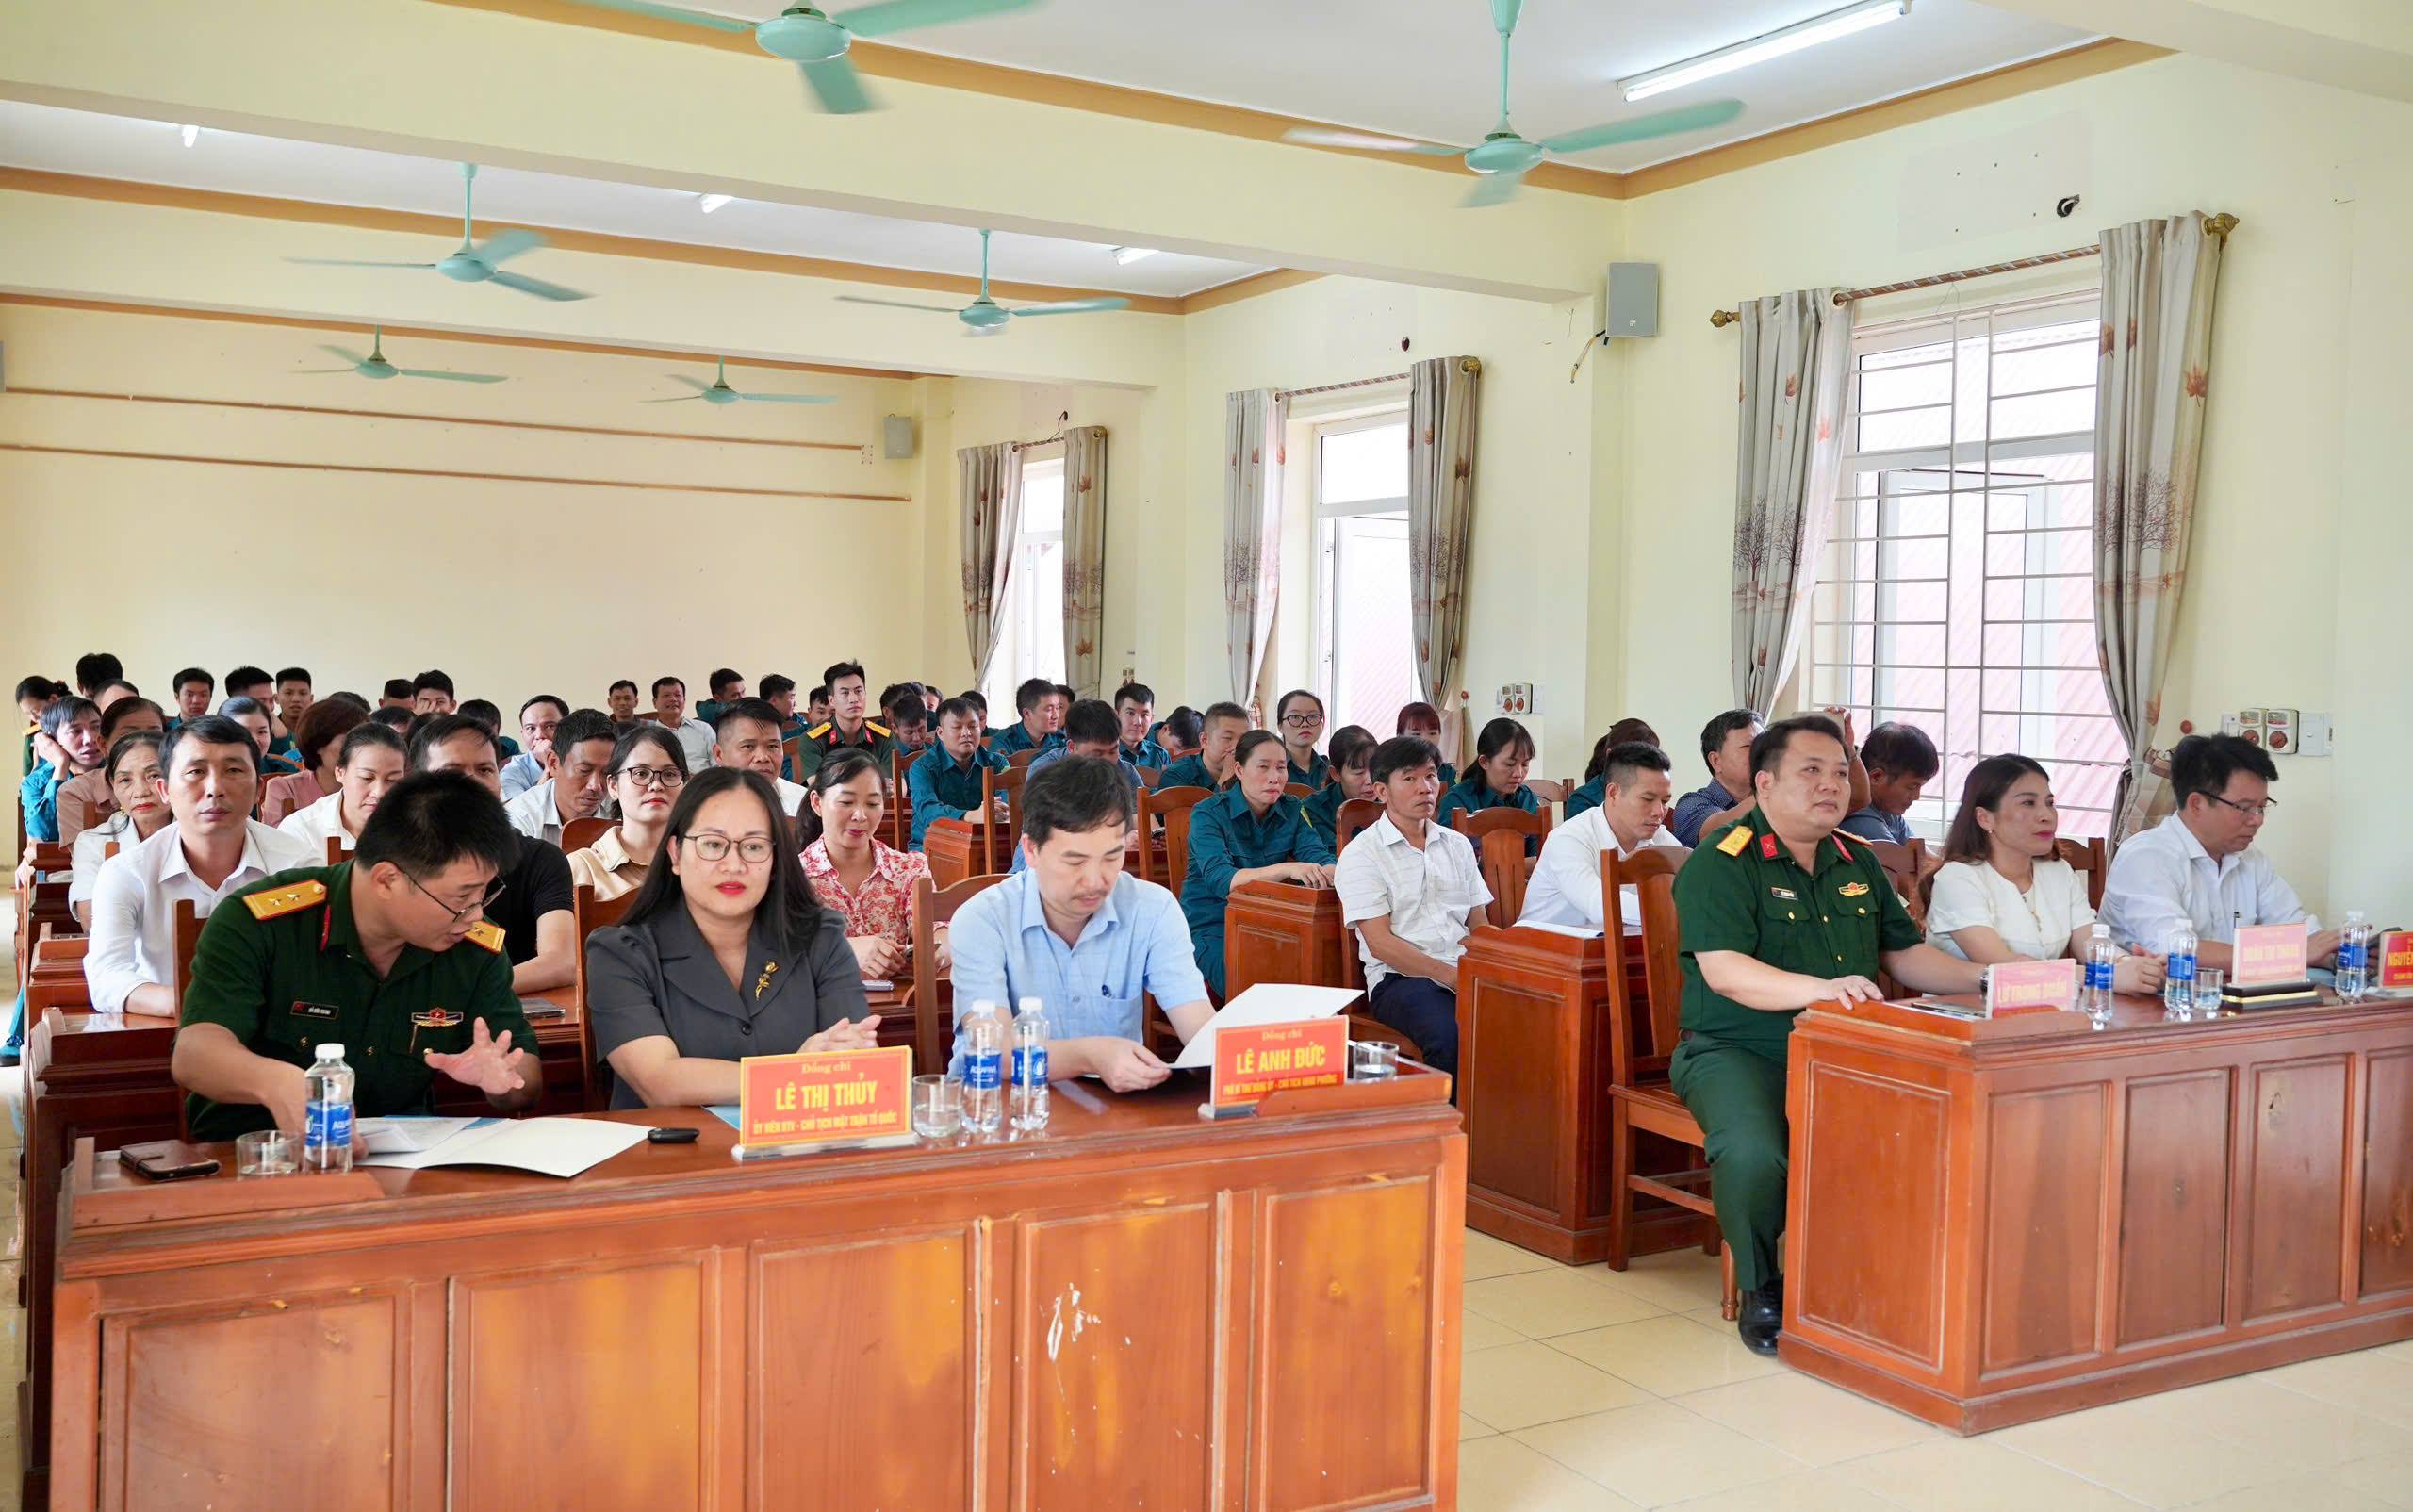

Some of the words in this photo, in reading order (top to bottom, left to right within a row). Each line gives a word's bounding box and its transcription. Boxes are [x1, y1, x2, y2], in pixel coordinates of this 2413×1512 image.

[801, 1061, 830, 1075] Đồng
[833, 1060, 851, 1073] chí
[1236, 1048, 1256, 1074] LÊ
[1258, 1048, 1290, 1072] ANH
[1295, 1040, 1326, 1069] ĐỨC
[776, 1081, 796, 1110] LÊ
[801, 1083, 829, 1112] THỊ
[834, 1072, 878, 1107] THỦY
